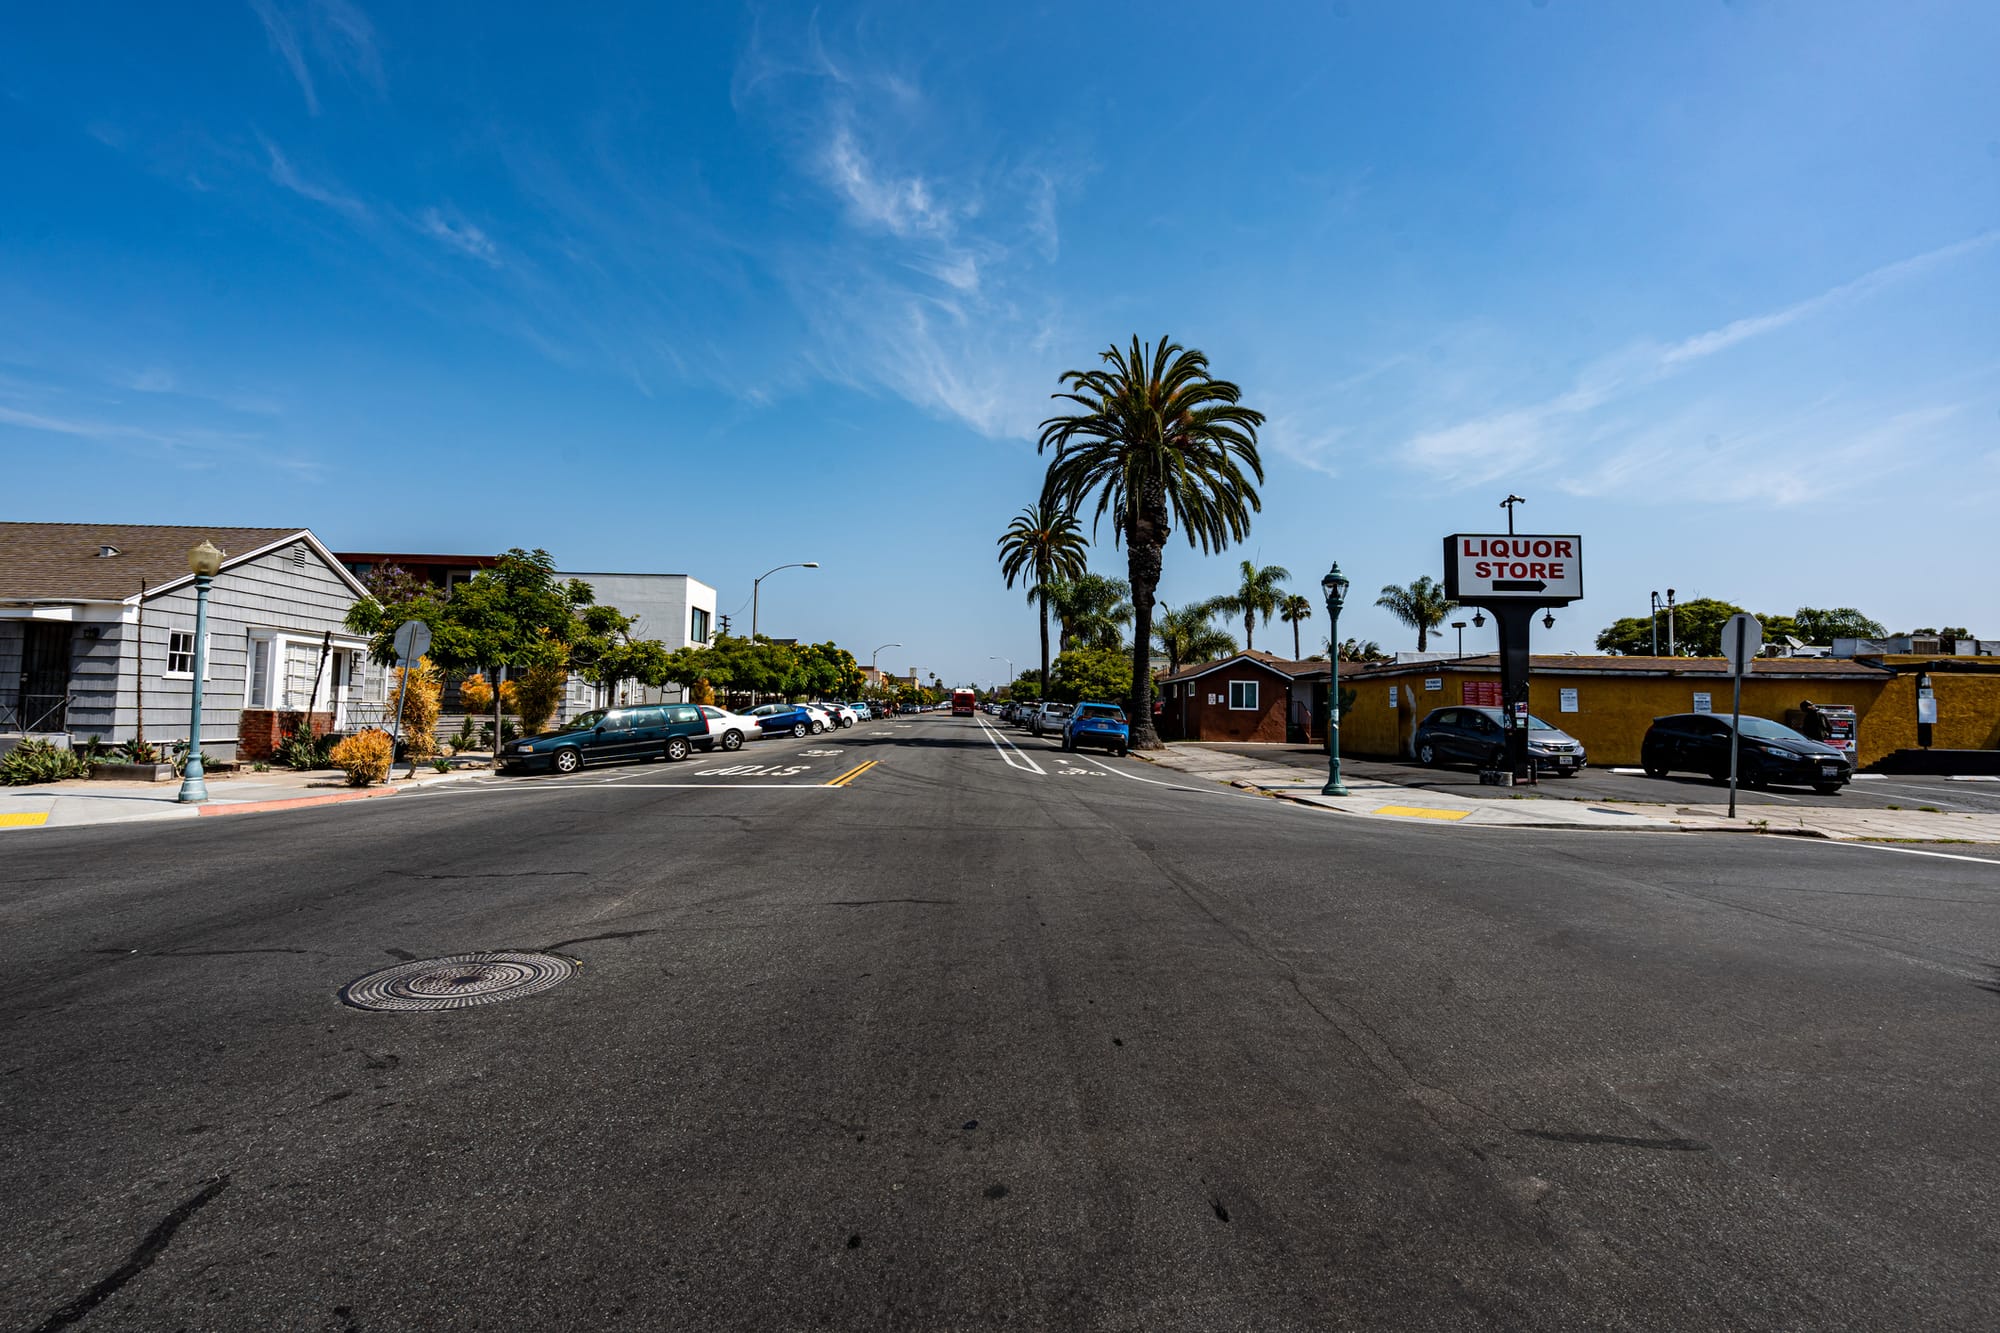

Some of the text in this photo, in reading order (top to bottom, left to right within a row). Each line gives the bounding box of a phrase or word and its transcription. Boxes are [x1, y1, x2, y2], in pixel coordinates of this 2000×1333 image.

[1463, 539, 1573, 559] LIQUOR
[1475, 562, 1565, 579] STORE
[694, 765, 812, 776] STOP
